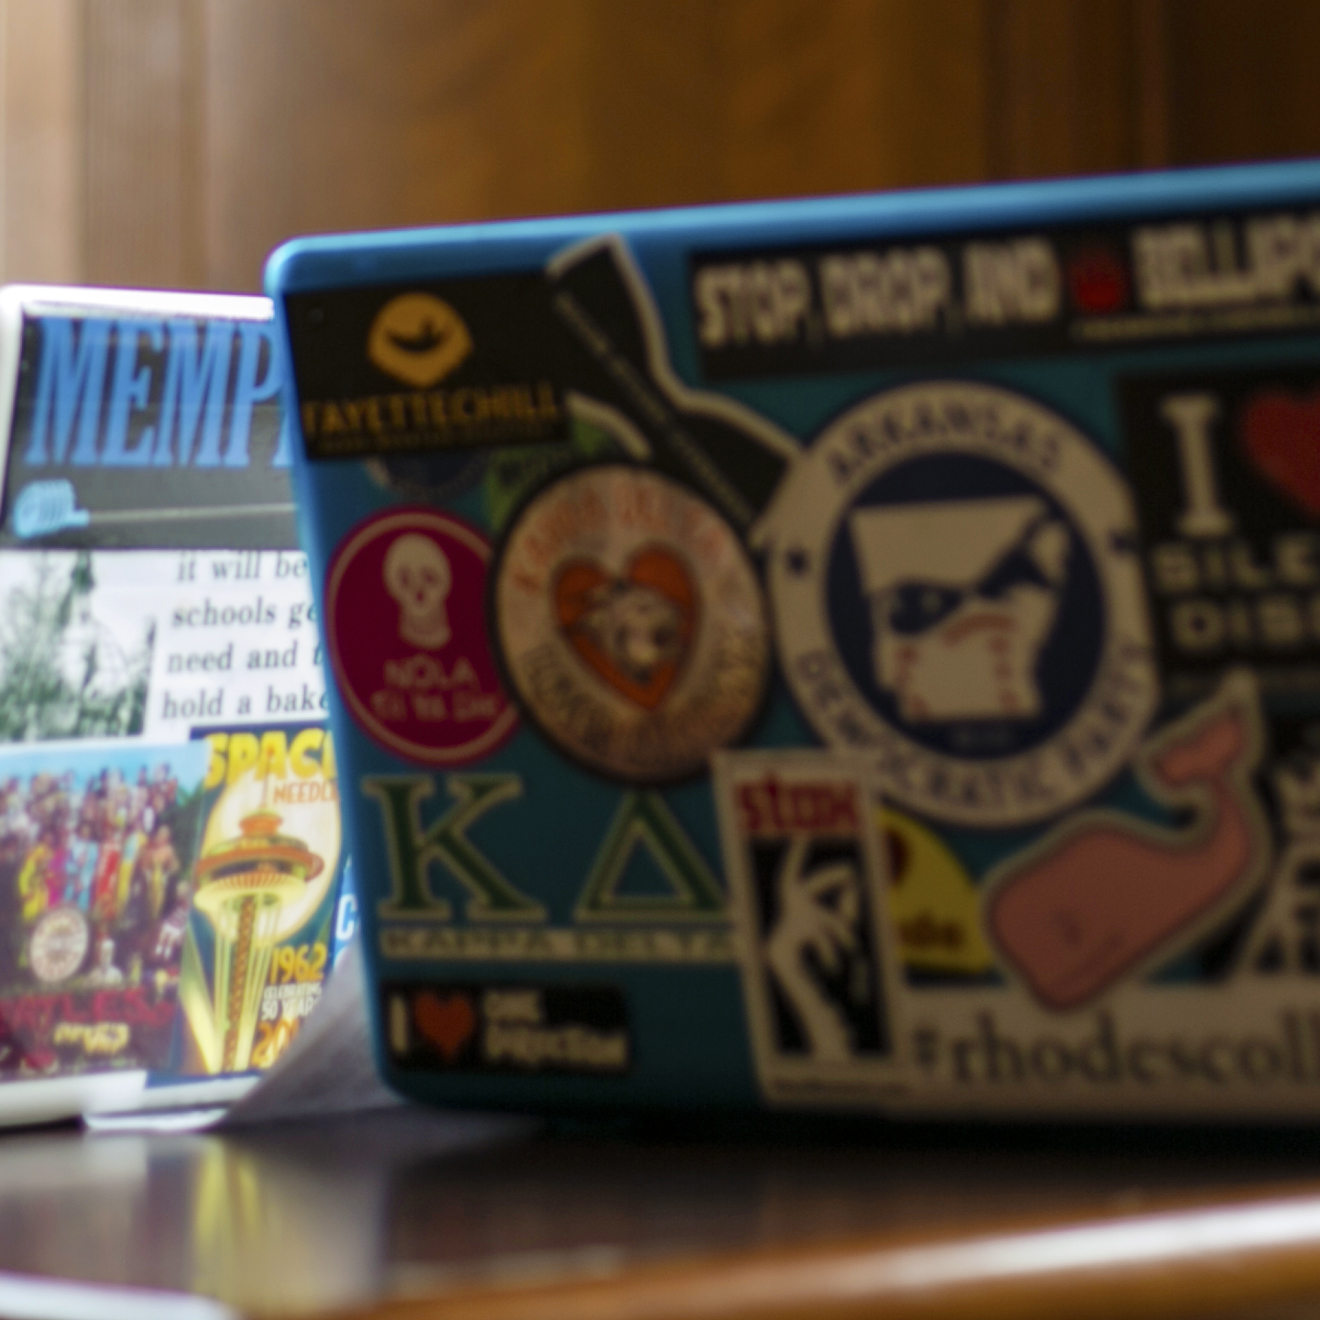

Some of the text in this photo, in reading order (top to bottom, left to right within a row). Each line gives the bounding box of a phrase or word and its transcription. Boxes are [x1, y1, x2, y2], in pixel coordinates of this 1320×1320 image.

[827, 402, 1062, 486] ARKANSAS
[1158, 390, 1236, 538] I
[211, 551, 262, 580] will
[273, 551, 307, 579] be
[171, 597, 276, 628] schools
[166, 644, 233, 674] need
[246, 638, 297, 669] and
[161, 687, 223, 720] hold
[236, 696, 252, 716] a
[1064, 646, 1145, 777] PARTY
[361, 775, 547, 922] K
[268, 941, 328, 986] 1962
[261, 1000, 279, 1022] 50
